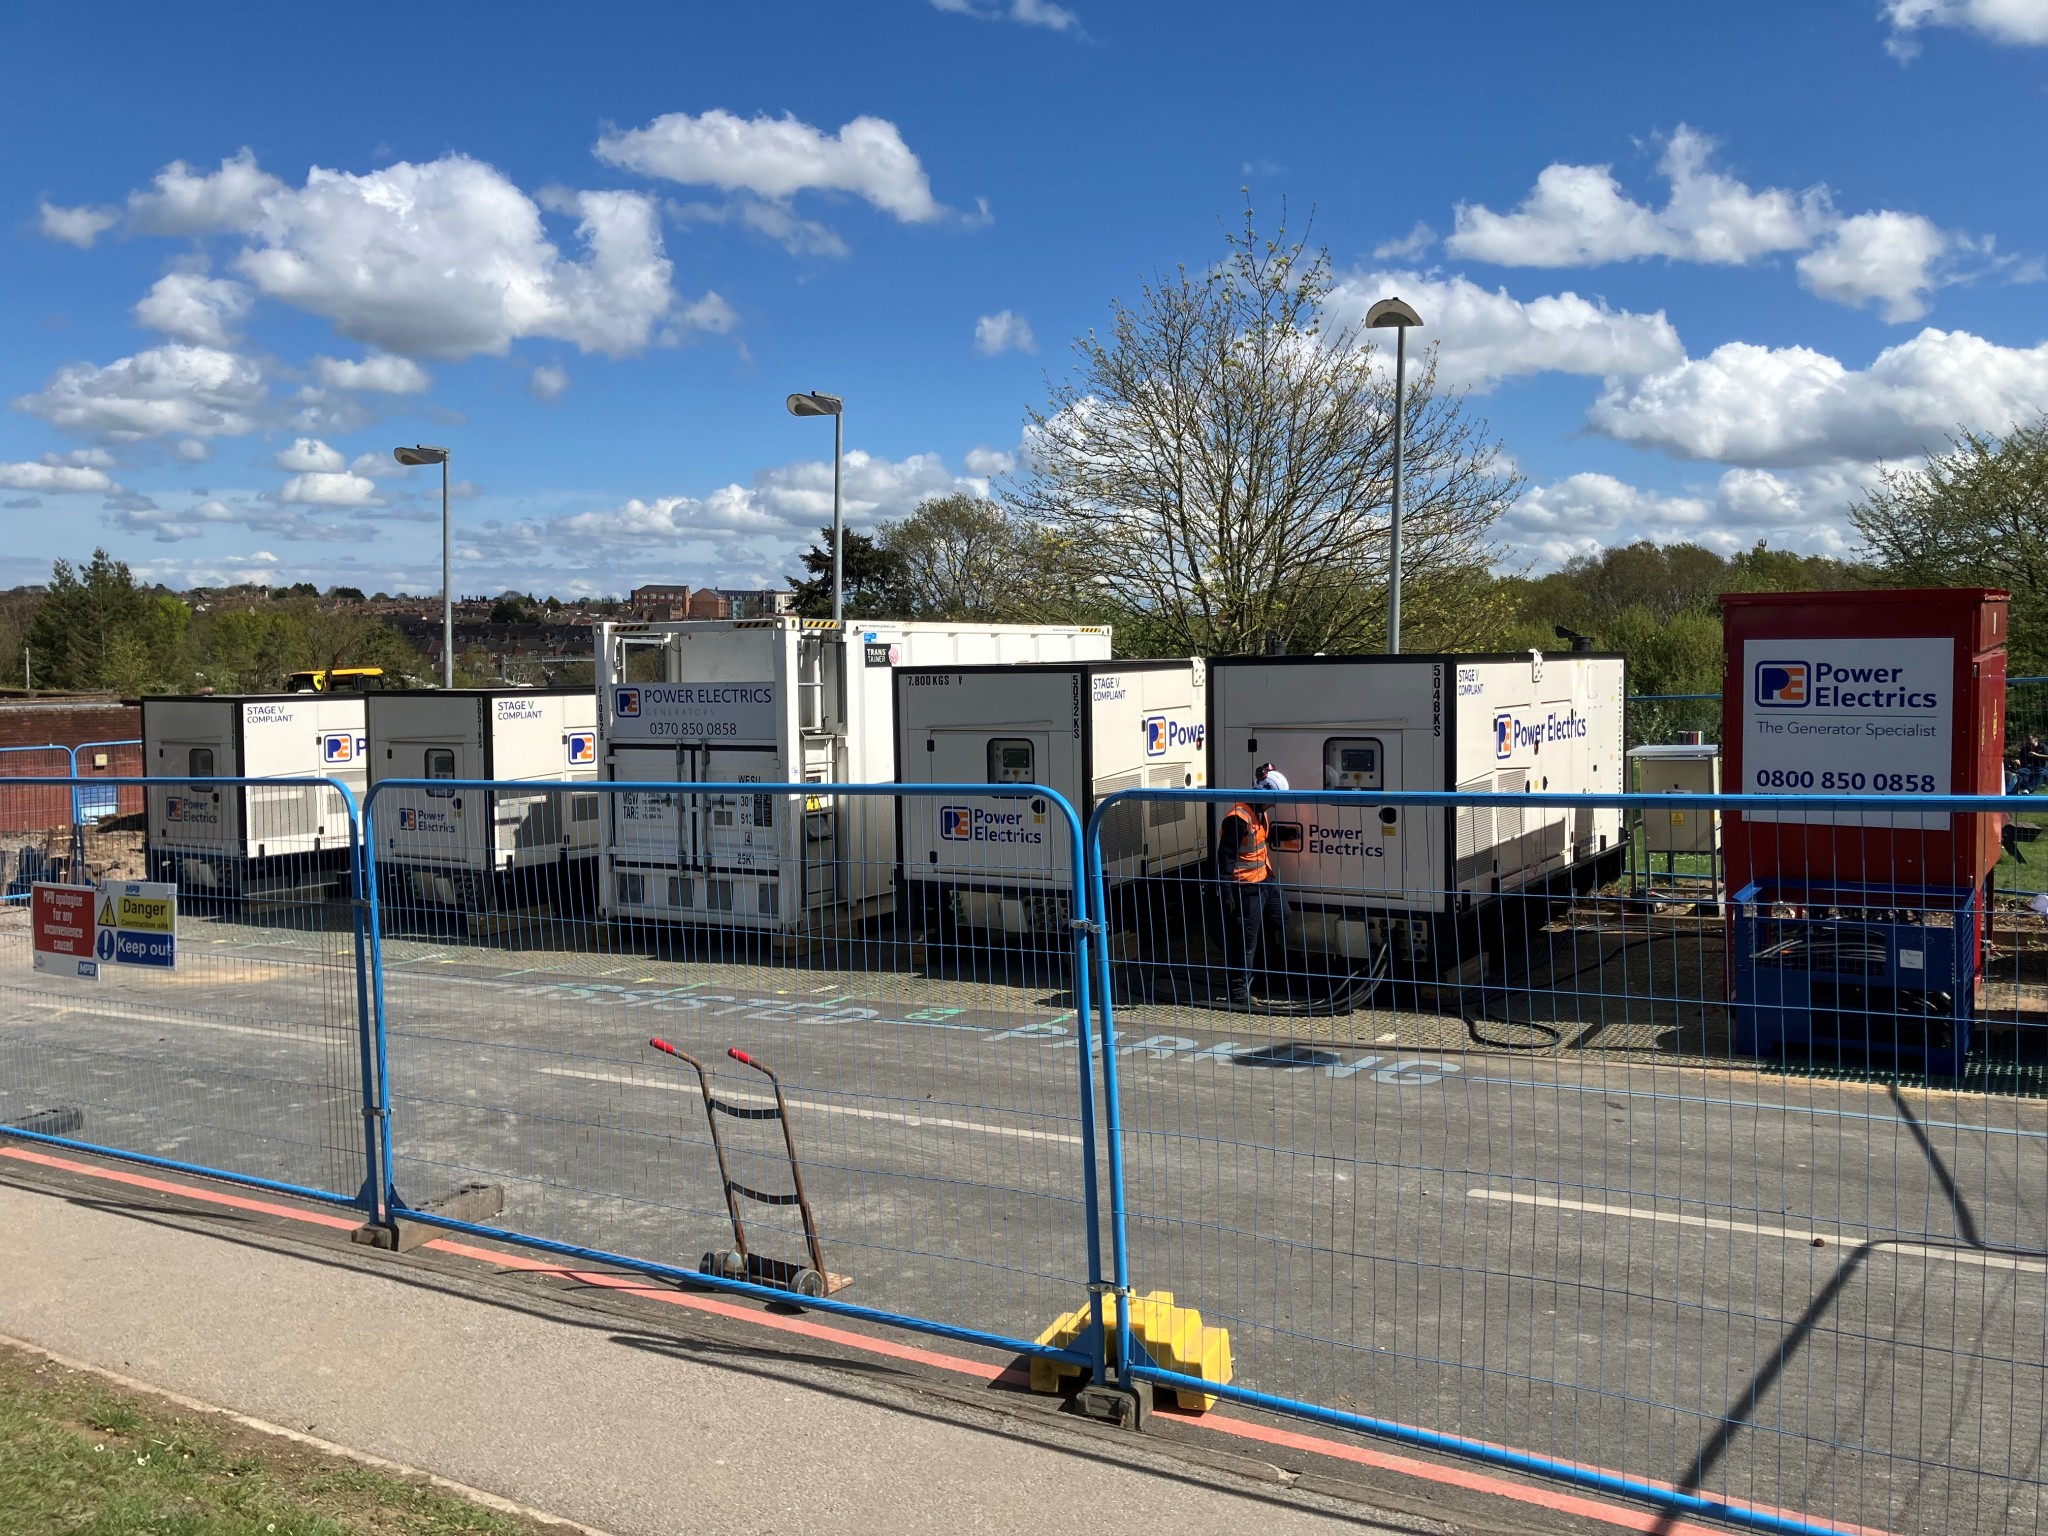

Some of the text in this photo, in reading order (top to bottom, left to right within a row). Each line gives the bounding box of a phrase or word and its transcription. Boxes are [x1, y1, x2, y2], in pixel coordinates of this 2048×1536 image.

[867, 648, 886, 656] TRANS
[1458, 668, 1480, 683] STAGE V
[1815, 662, 1903, 683] Power
[908, 676, 931, 687] 7.800
[933, 675, 950, 686] KGS
[1093, 677, 1121, 689] STAGE V
[645, 688, 772, 704] POWER ELECTRICS
[1093, 689, 1126, 701] COMPLIANT
[1458, 683, 1484, 696] COMPLIANT
[1433, 665, 1441, 737] 5048KS
[1815, 686, 1937, 708] Electrics
[247, 706, 284, 715] STAGE V
[498, 700, 534, 711] STAGE V
[646, 708, 715, 716] GENERATORS
[1072, 675, 1080, 739] 5052KS
[247, 714, 294, 724] COMPLIANT
[498, 711, 542, 720] COMPLIANT
[650, 723, 737, 736] 0370 850 0858
[1514, 711, 1586, 748] Power Electrics
[1757, 721, 1937, 740] The Generator Specialist
[1756, 770, 1936, 793] 0800 850 0858
[183, 799, 207, 811] Power
[184, 812, 218, 824] Electrics
[418, 810, 444, 821] Power
[974, 809, 1022, 825] Power
[418, 821, 456, 833] Electrics
[1308, 824, 1362, 840] Power
[974, 826, 1042, 844] Electrics
[1308, 841, 1384, 858] Electrics
[56, 893, 83, 909] apologise
[123, 899, 166, 918] Danger
[53, 910, 72, 924] for any
[44, 923, 83, 938] inconvenience
[121, 919, 168, 930] Construction site
[54, 940, 74, 952] caused
[118, 937, 172, 958] Keep out
[79, 963, 95, 975] MPB
[983, 1023, 1462, 1085] PARKING
